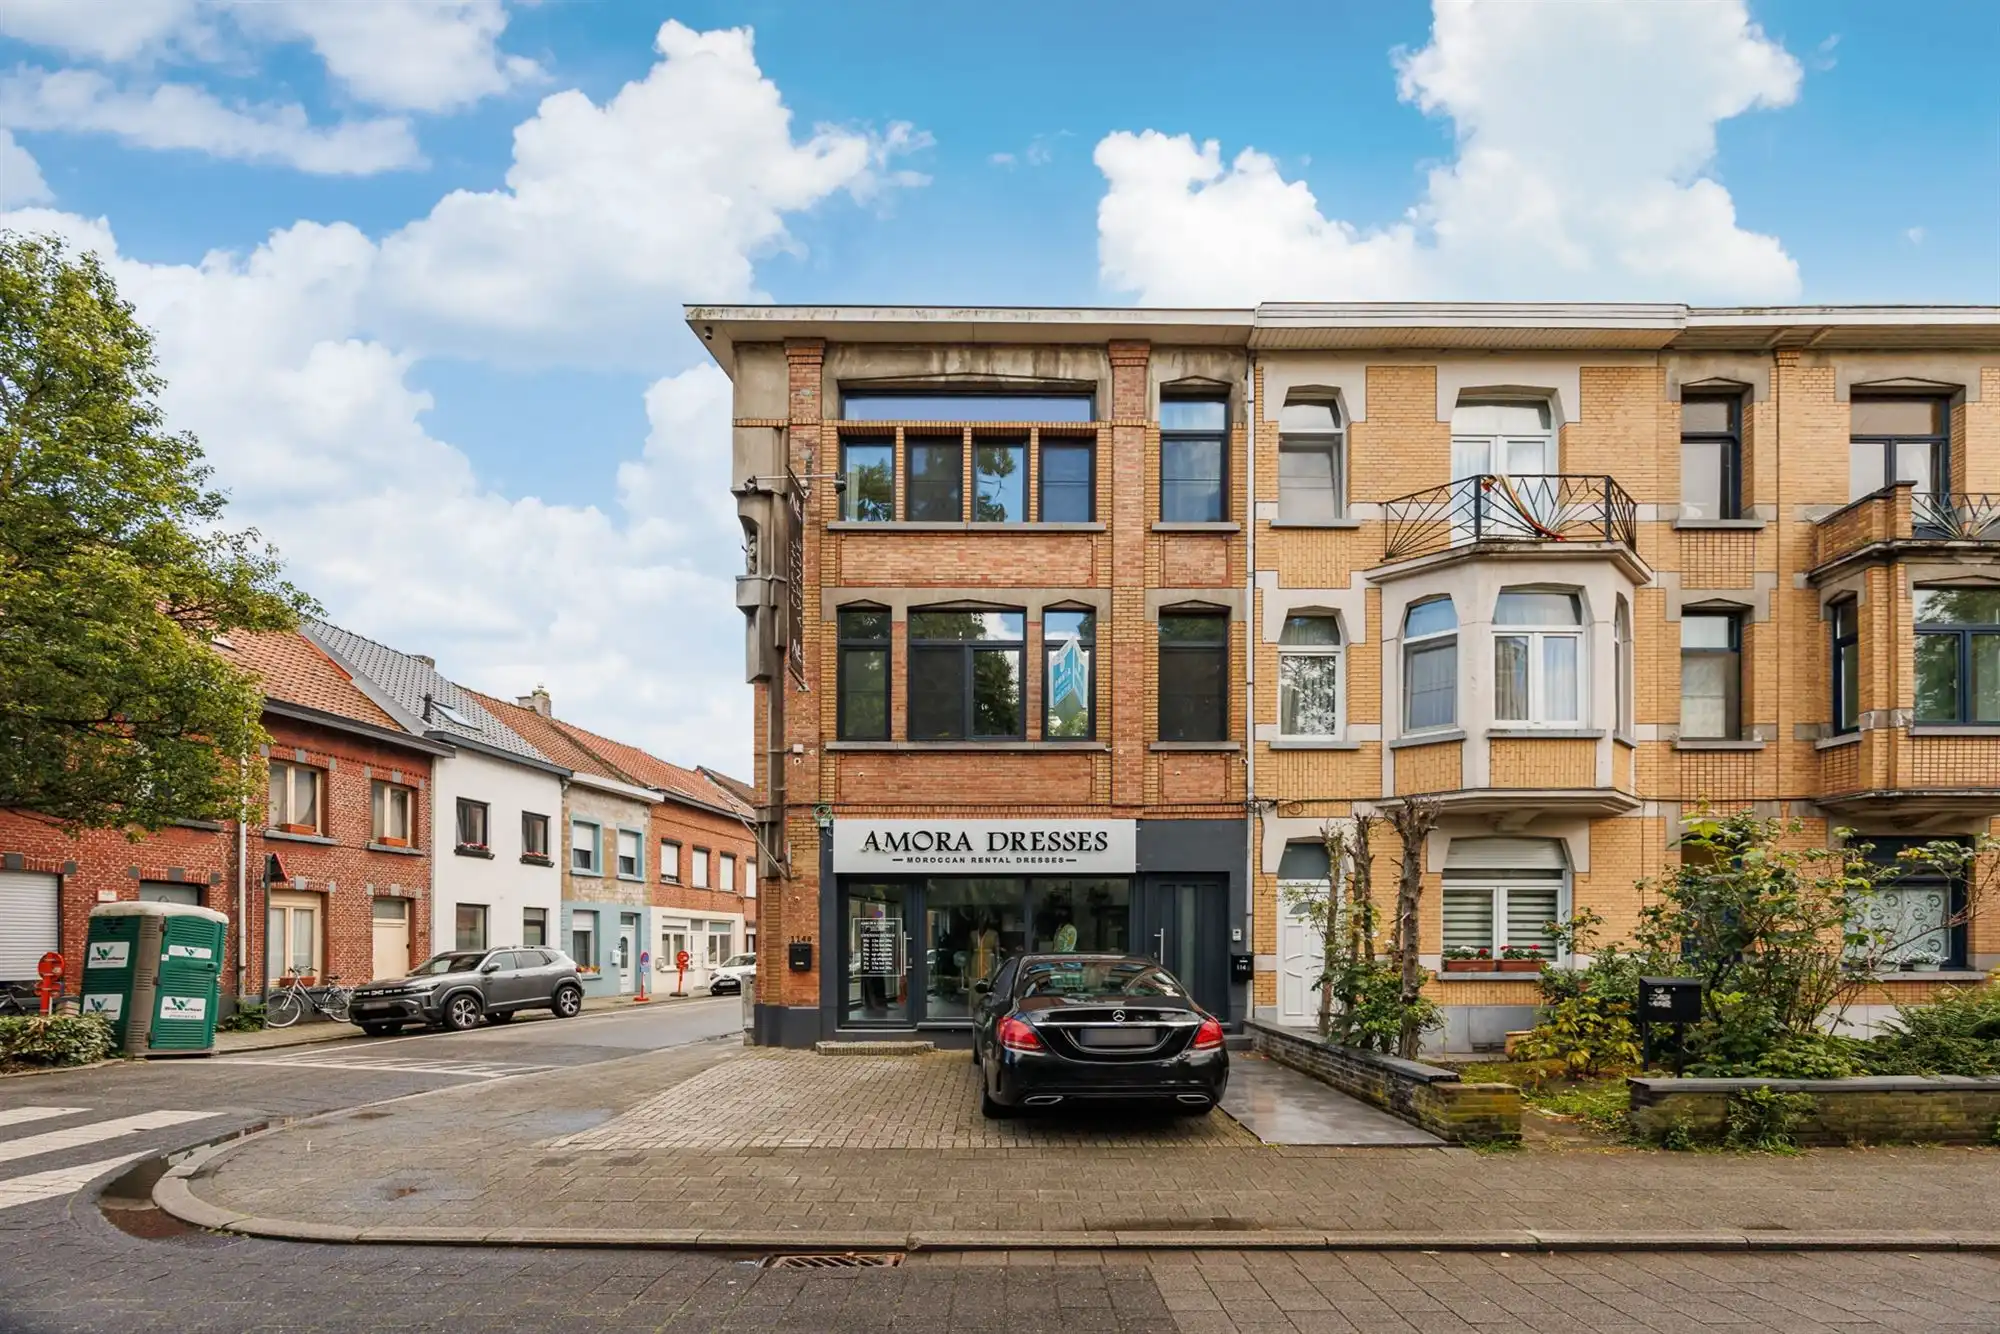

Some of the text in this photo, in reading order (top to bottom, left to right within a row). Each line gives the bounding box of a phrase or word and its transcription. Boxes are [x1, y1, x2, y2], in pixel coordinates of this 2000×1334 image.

[860, 830, 1109, 853] AMORA DRESSES
[906, 856, 1065, 864] MOROCCAN RENTAL DRESSES
